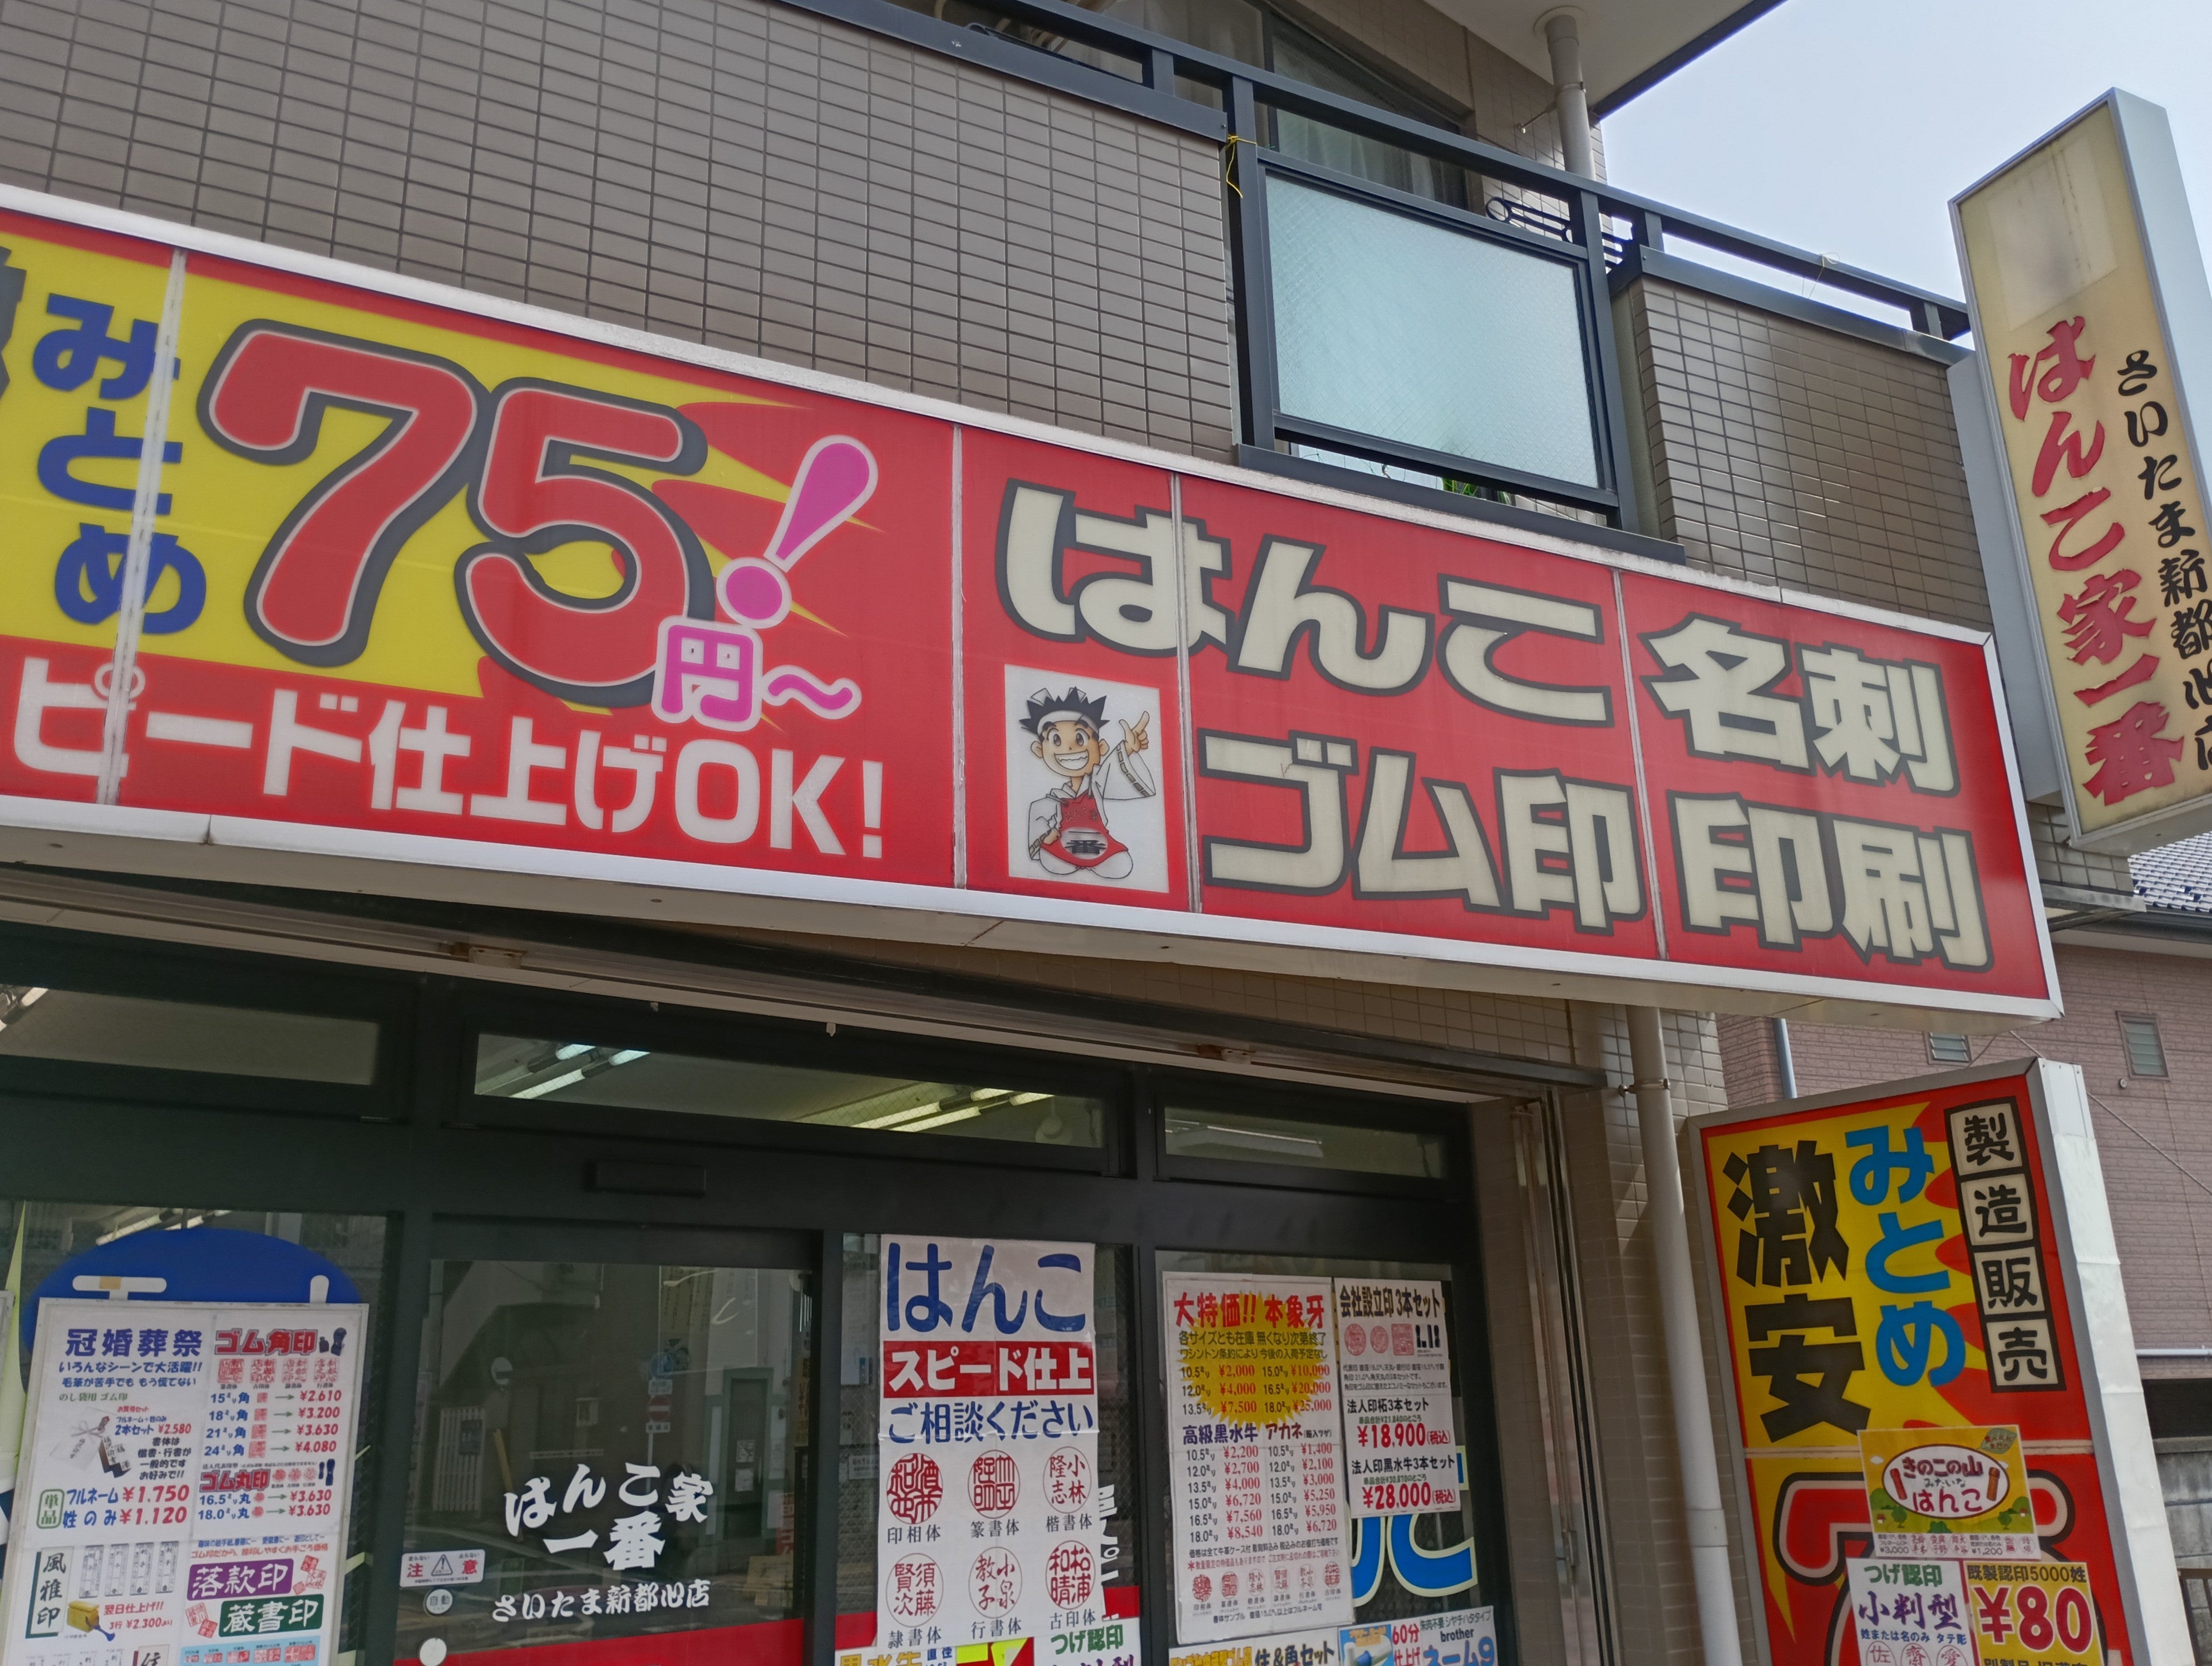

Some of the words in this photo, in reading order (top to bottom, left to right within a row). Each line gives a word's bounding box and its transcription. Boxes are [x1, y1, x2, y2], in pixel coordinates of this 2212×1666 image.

[2007, 316, 2184, 806] はんこ家一番
[995, 478, 1615, 727] はんこ
[1638, 611, 1961, 797] 名刺
[1198, 728, 1648, 935] ゴム印
[1666, 790, 1995, 973] 印刷
[1845, 1124, 1966, 1387] みとめ
[1963, 1111, 2048, 1380] 製造販売
[886, 1242, 1086, 1334] はんこ
[1339, 1284, 1395, 1318] 会社設立印
[1395, 1287, 1440, 1318] 3本セット
[1722, 1139, 1871, 1443] 激安
[1174, 1291, 1257, 1328] 大特価!!
[1264, 1294, 1324, 1329] 本象牙
[65, 1328, 203, 1358] 冠婚葬祭
[214, 1328, 318, 1357] ゴム角印
[1179, 1330, 1255, 1346] 各サイズとも在庫
[889, 1346, 1092, 1392] スピード仕上
[115, 1424, 154, 1436] 2本セット
[889, 1399, 1093, 1444] ご相談ください
[1182, 1423, 1259, 1446] 高級黒水牛
[152, 1437, 180, 1446] 書体は
[140, 1459, 186, 1469] 一般的です
[1902, 1455, 1983, 1477] きのこの山
[66, 1487, 119, 1505] フルネーム
[199, 1468, 271, 1493] ゴム丸印
[1924, 1477, 1966, 1488] みたいな
[503, 1462, 713, 1537] はんこ家
[1912, 1490, 1983, 1513] はんこ
[542, 1511, 667, 1571] 一番
[886, 1526, 942, 1545] 印相体
[1046, 1513, 1093, 1532] 楷書体
[37, 1552, 67, 1628] 風雅印
[192, 1563, 289, 1599] 落款印
[1864, 1564, 1943, 1587] つげ認印
[1967, 1565, 2087, 1584] 既製認印5000姓
[223, 1599, 319, 1634] 蔵書印
[492, 1579, 712, 1623] さいたま新都心店
[1859, 1591, 1963, 1631] 小判型
[971, 1617, 1022, 1639] 行書体
[1049, 1609, 1096, 1630] 古印体
[1392, 1623, 1420, 1645] 60分
[1973, 1585, 2092, 1653] ¥80
[1051, 1624, 1124, 1655] つげ認印
[1440, 1628, 1474, 1643] brother
[1860, 1628, 1930, 1643] 姓または名のみ
